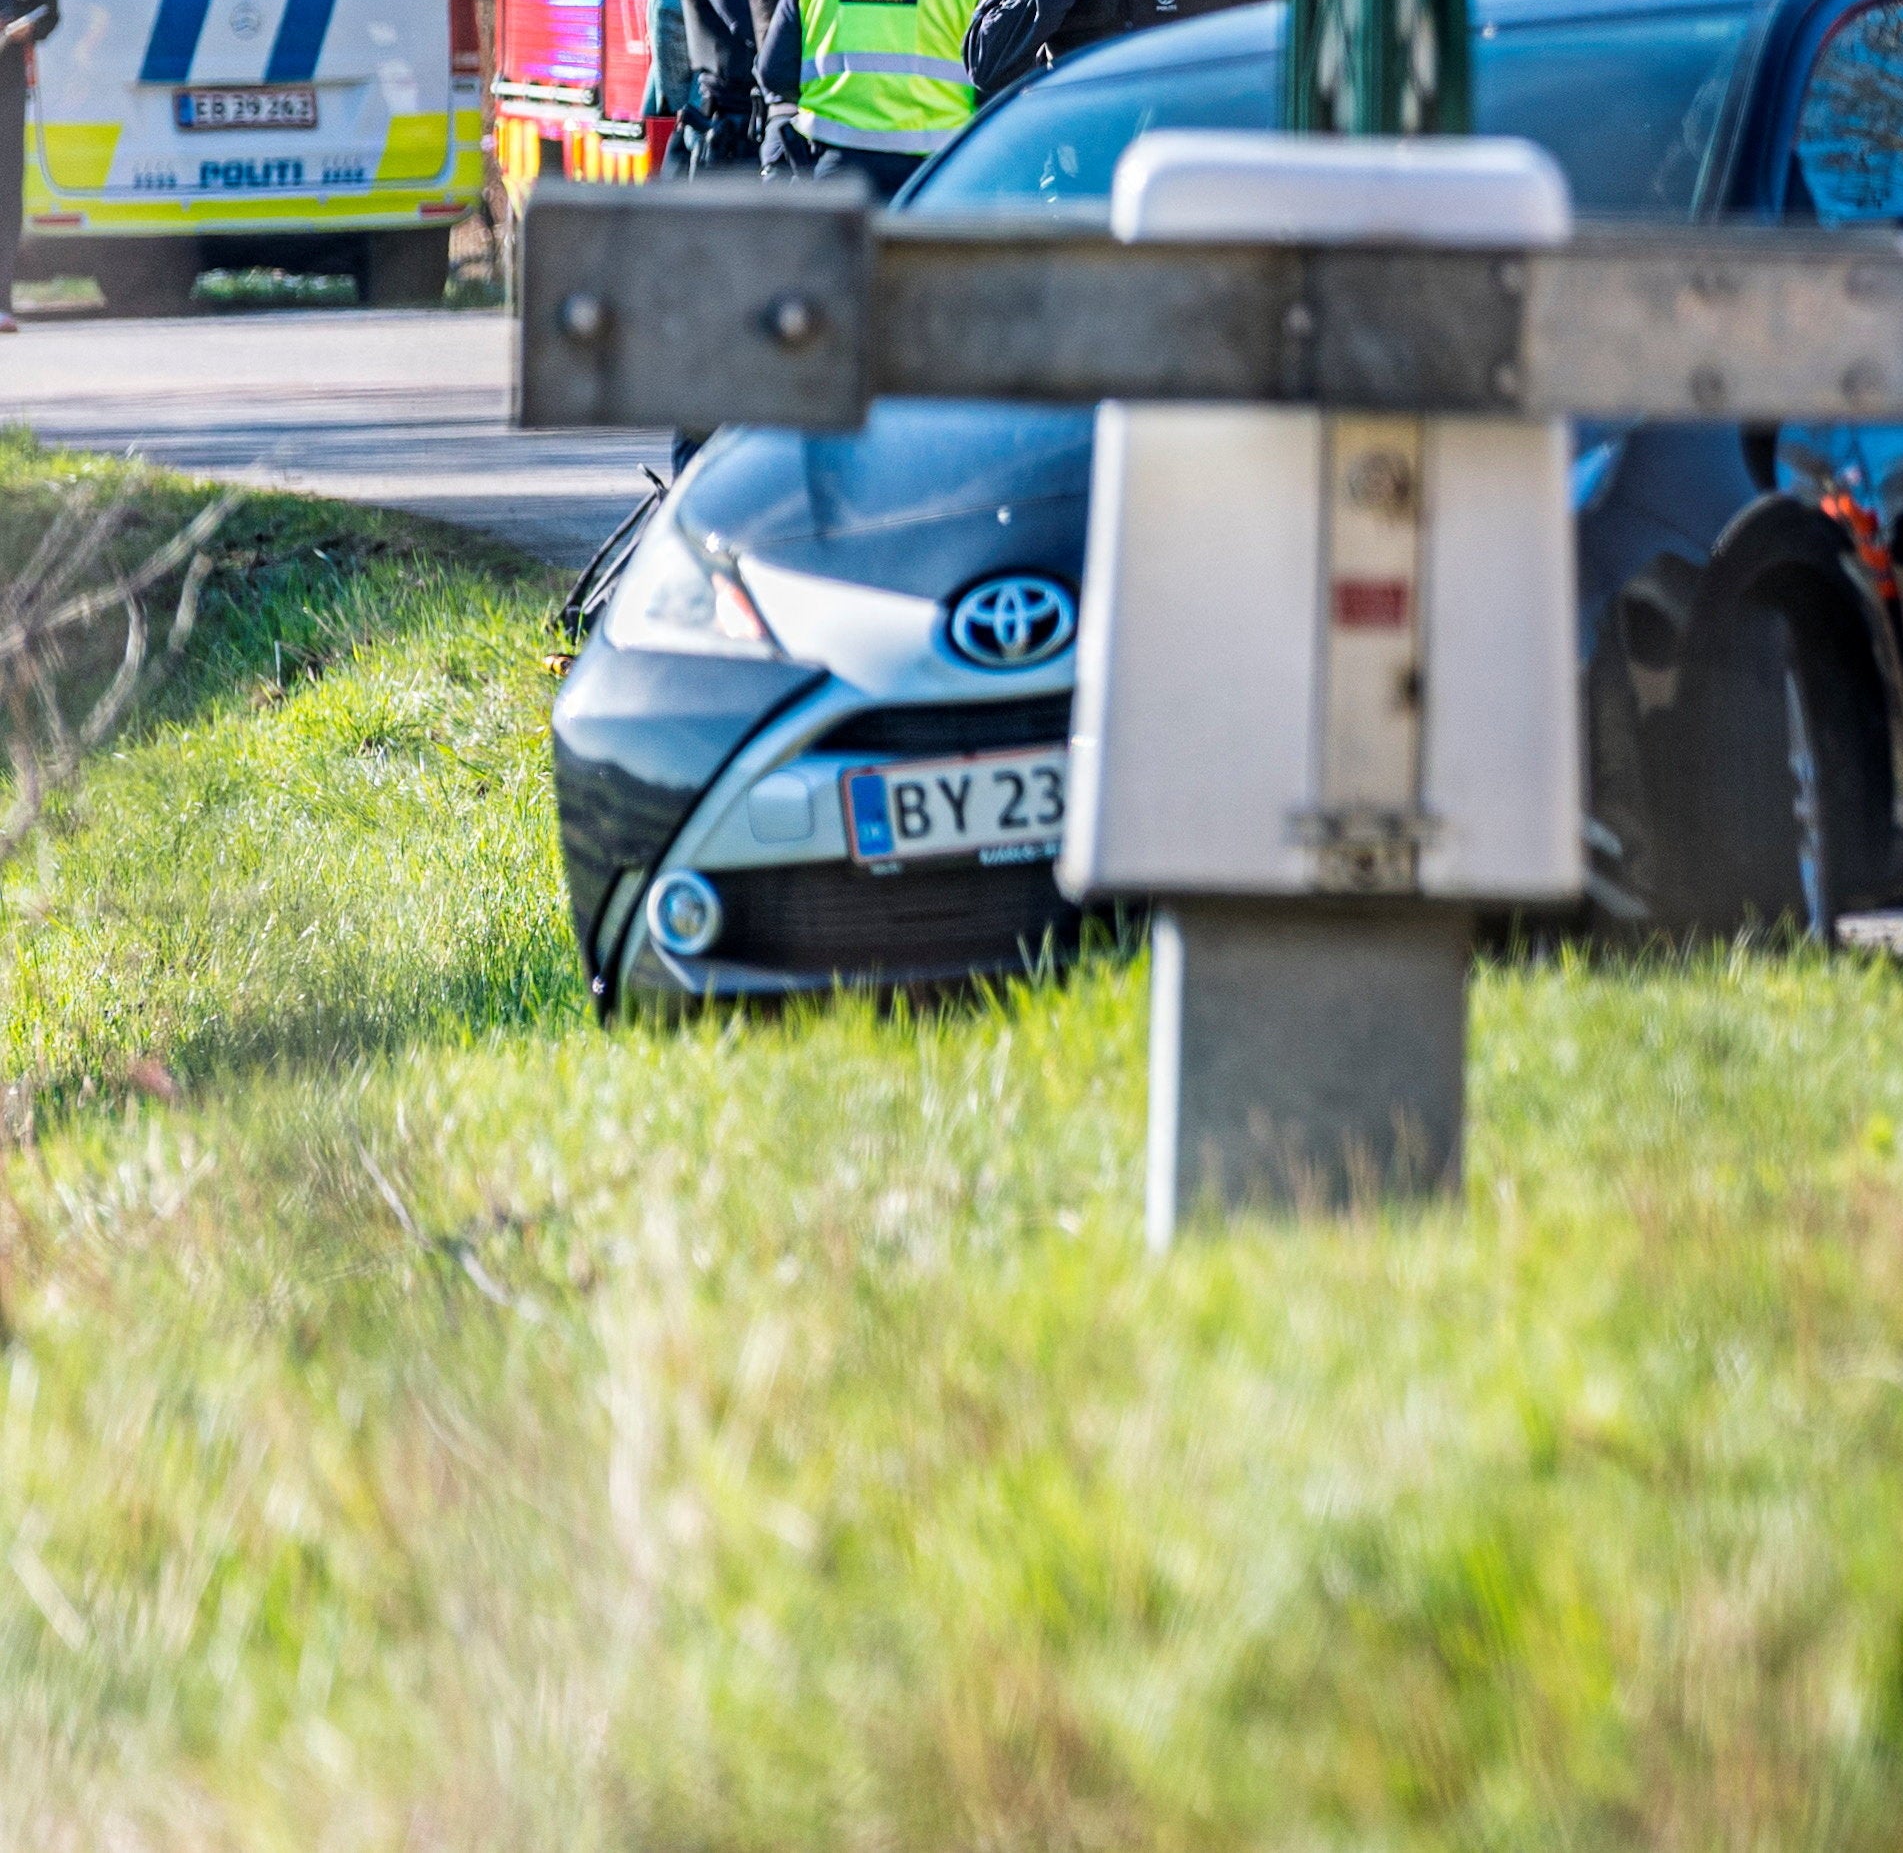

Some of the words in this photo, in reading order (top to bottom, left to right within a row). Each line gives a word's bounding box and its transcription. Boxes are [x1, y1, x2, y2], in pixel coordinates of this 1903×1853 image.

[199, 157, 304, 189] POLITI
[895, 774, 972, 840] BY
[993, 766, 1066, 831] 23
